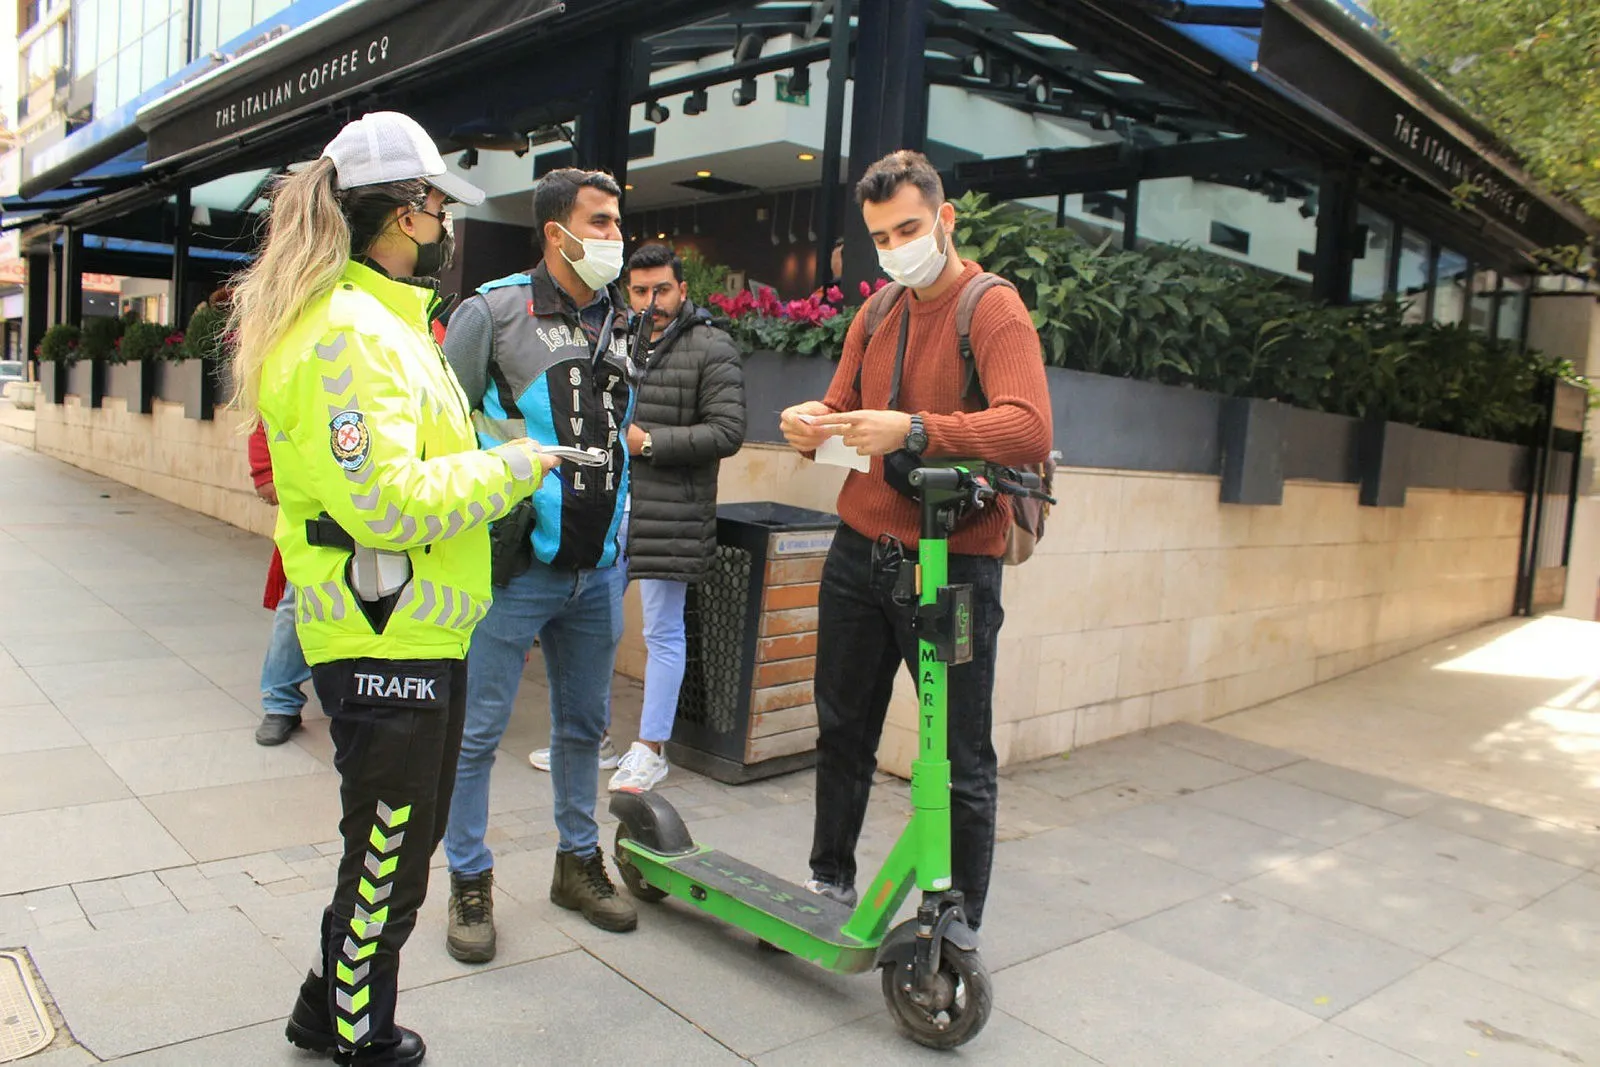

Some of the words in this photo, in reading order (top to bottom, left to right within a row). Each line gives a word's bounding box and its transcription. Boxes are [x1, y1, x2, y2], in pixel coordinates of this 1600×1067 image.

[215, 104, 236, 128] THE
[241, 80, 292, 118] ITALIAN
[298, 50, 359, 94] COFFEE
[1394, 113, 1420, 149] THE
[921, 648, 936, 750] MARTI
